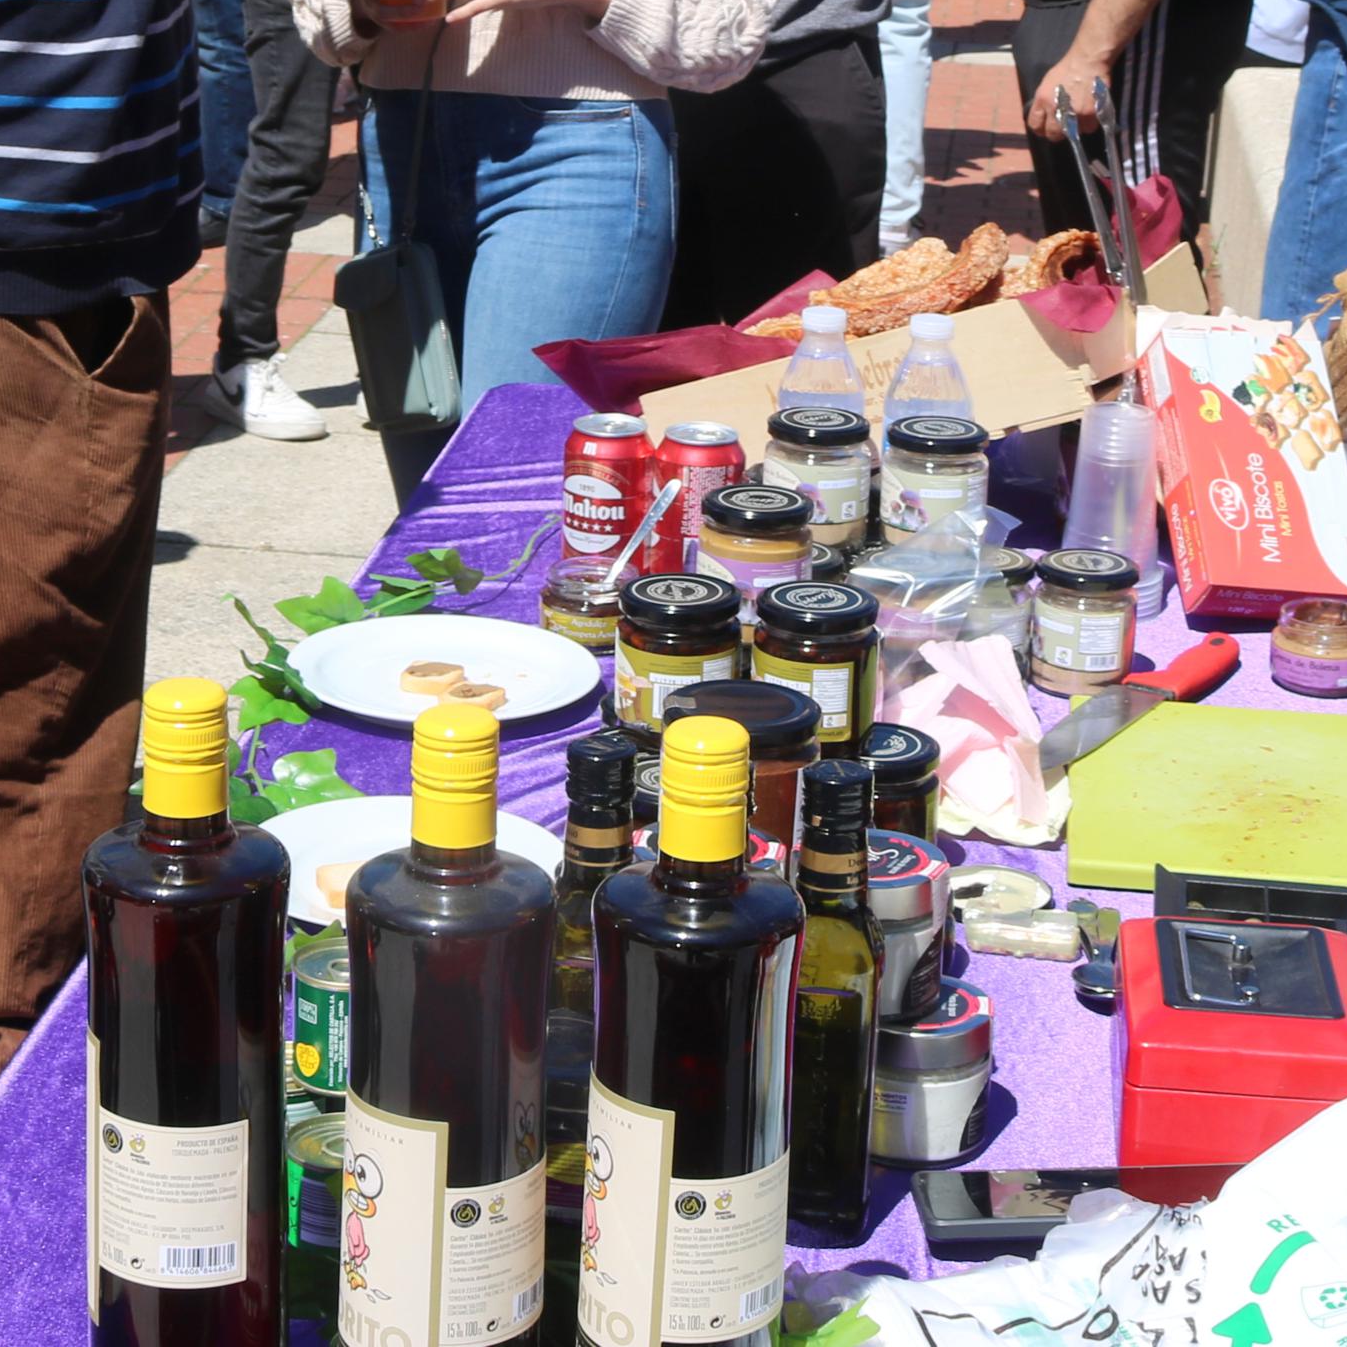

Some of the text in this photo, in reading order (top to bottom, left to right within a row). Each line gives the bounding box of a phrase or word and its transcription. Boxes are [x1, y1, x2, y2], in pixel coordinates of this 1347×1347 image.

[564, 493, 625, 521] Mahou
[1245, 451, 1283, 564] Mini Biscote
[176, 1138, 207, 1148] PRODUCTO
[339, 1300, 412, 1347] RITO
